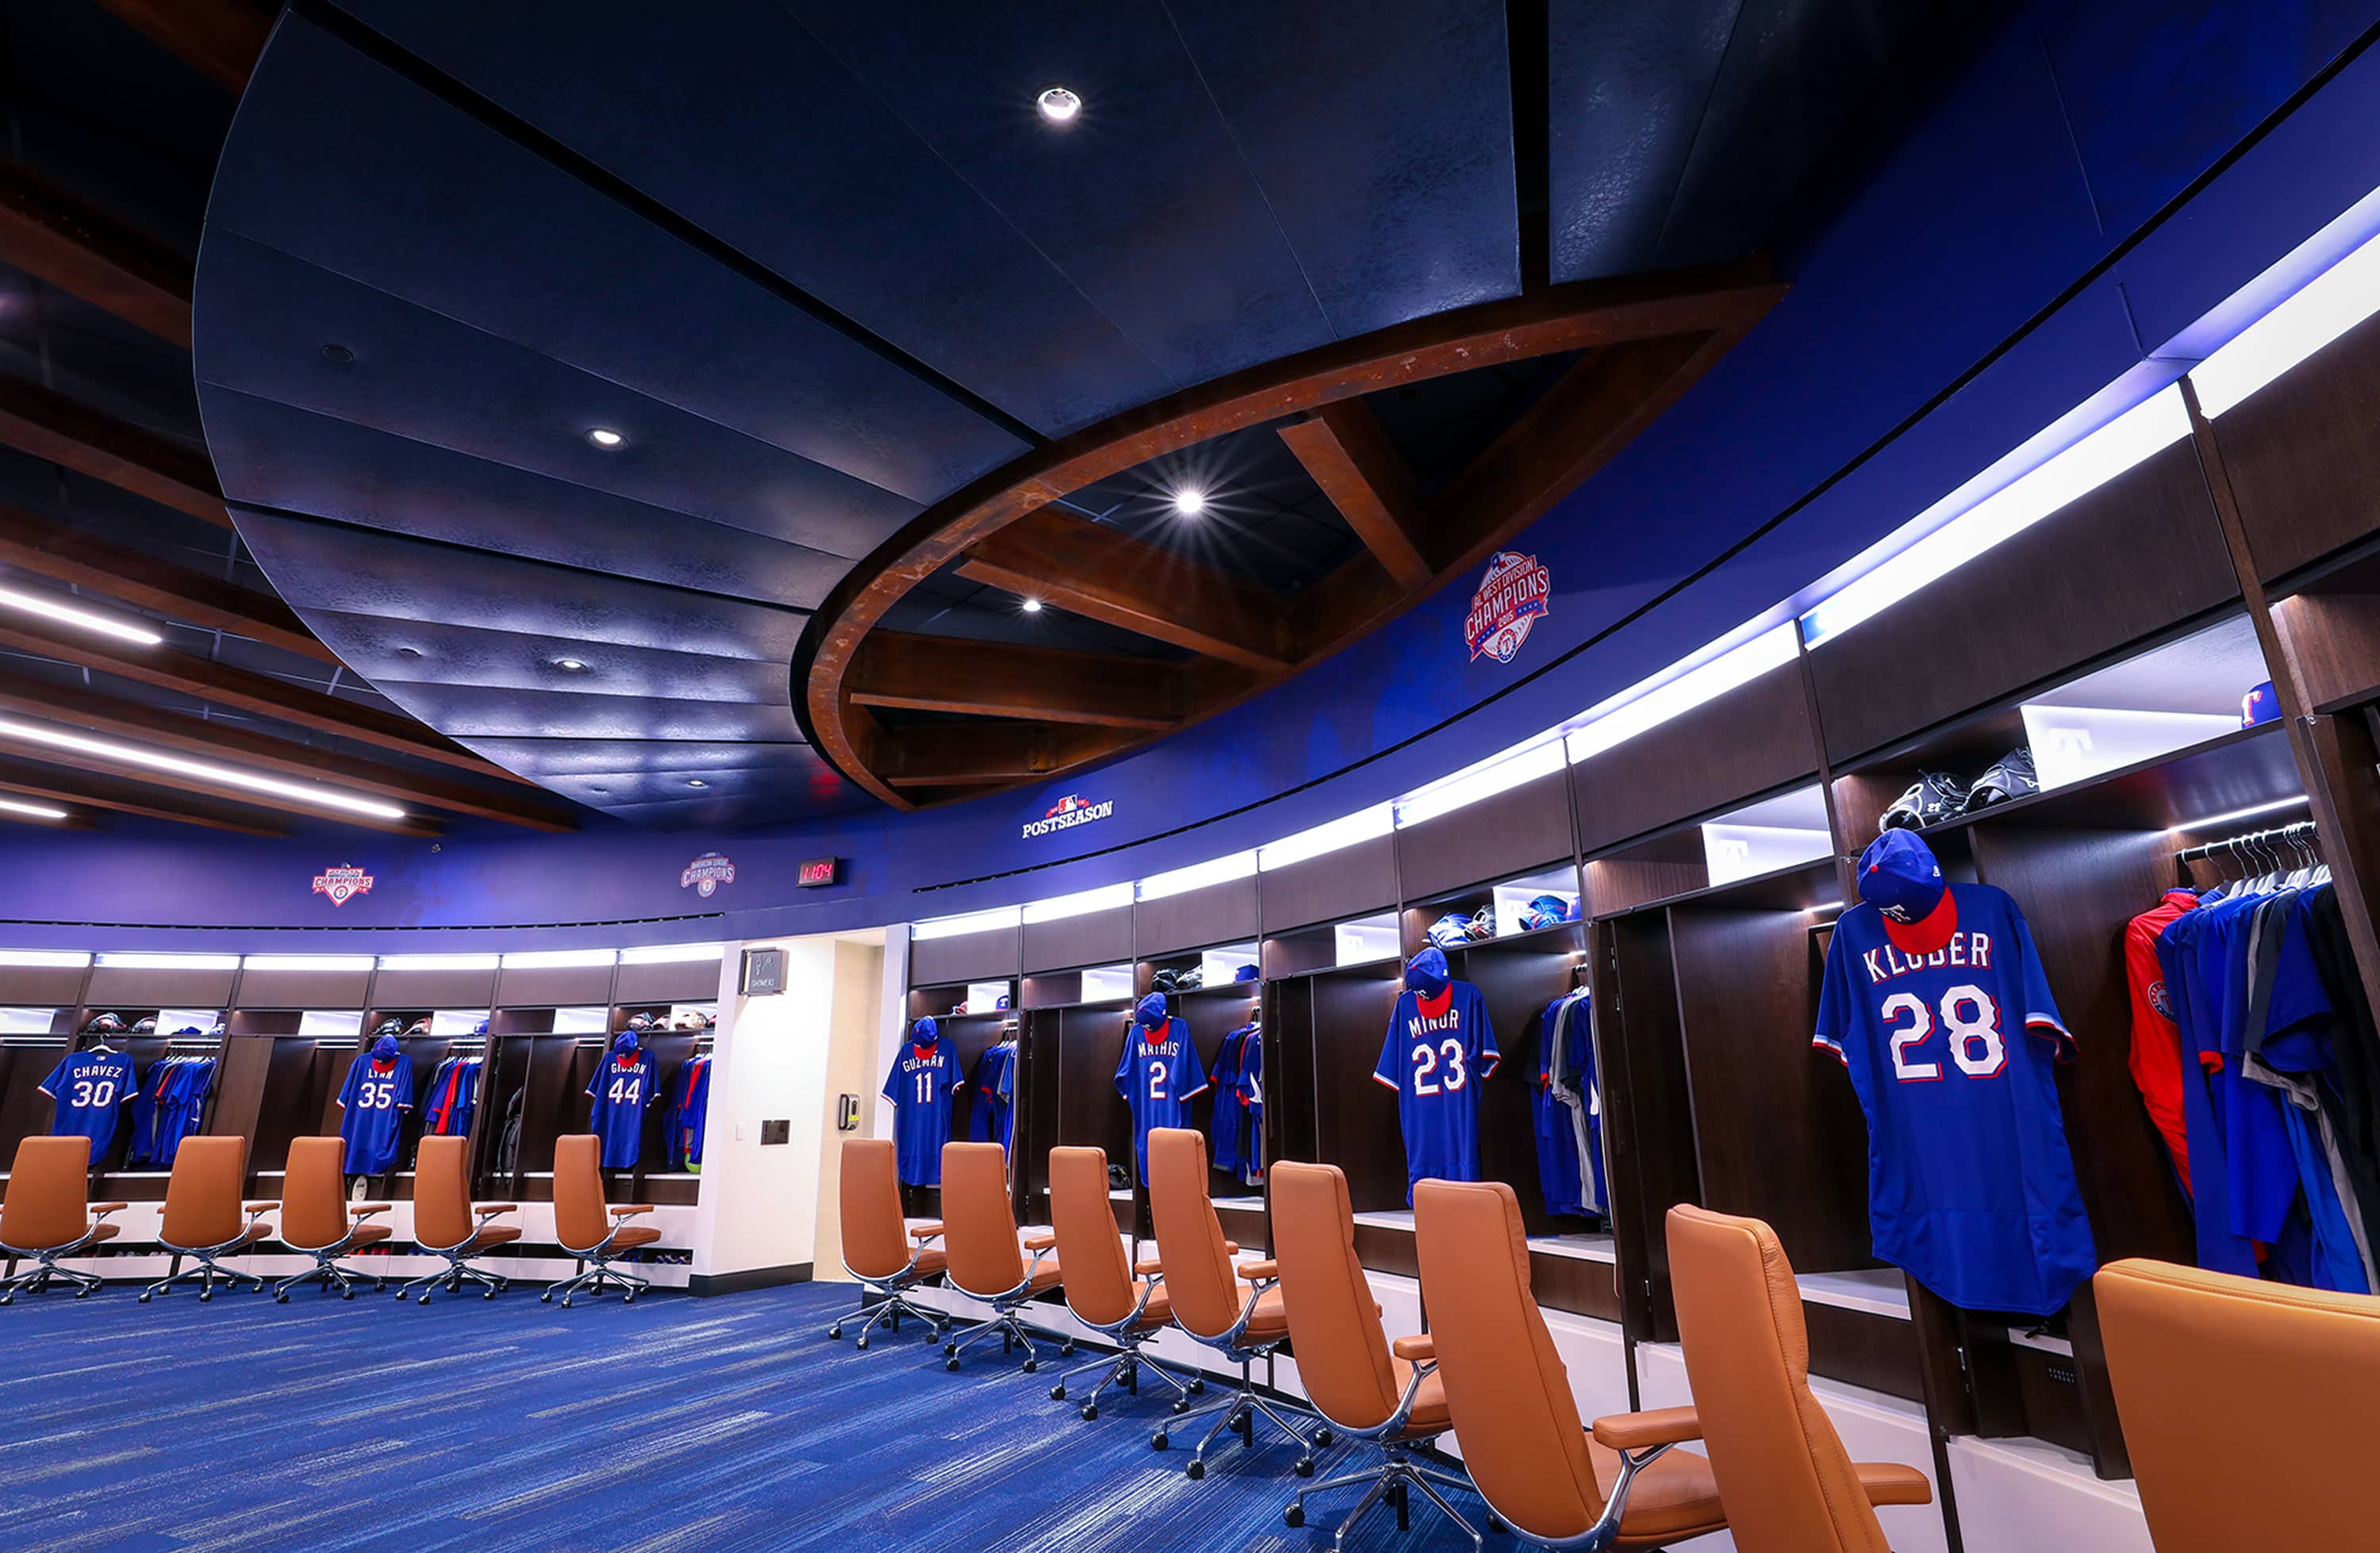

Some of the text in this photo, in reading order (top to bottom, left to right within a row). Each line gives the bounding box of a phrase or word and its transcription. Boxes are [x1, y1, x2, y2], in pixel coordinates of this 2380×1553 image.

[1483, 577, 1502, 601] WEST
[1502, 558, 1534, 587] DIVISION
[1467, 569, 1547, 641] CHAMPIONS
[1499, 610, 1514, 627] 2015
[1022, 800, 1113, 838] POSTSEASON
[315, 877, 371, 887] CHAMPIONS
[684, 866, 734, 884] CHAMPIONS
[1407, 1008, 1460, 1039] MINOR
[1880, 984, 2008, 1083] 28
[1138, 1040, 1180, 1058] MATHIS
[73, 1064, 123, 1079] CHAVEZ
[368, 1068, 394, 1079] LYNN
[1149, 1060, 1168, 1100] 2
[1411, 1037, 1467, 1097] 23
[71, 1080, 115, 1107] 30
[357, 1082, 395, 1110] 35
[608, 1077, 641, 1106] 44
[915, 1072, 933, 1104] 11
